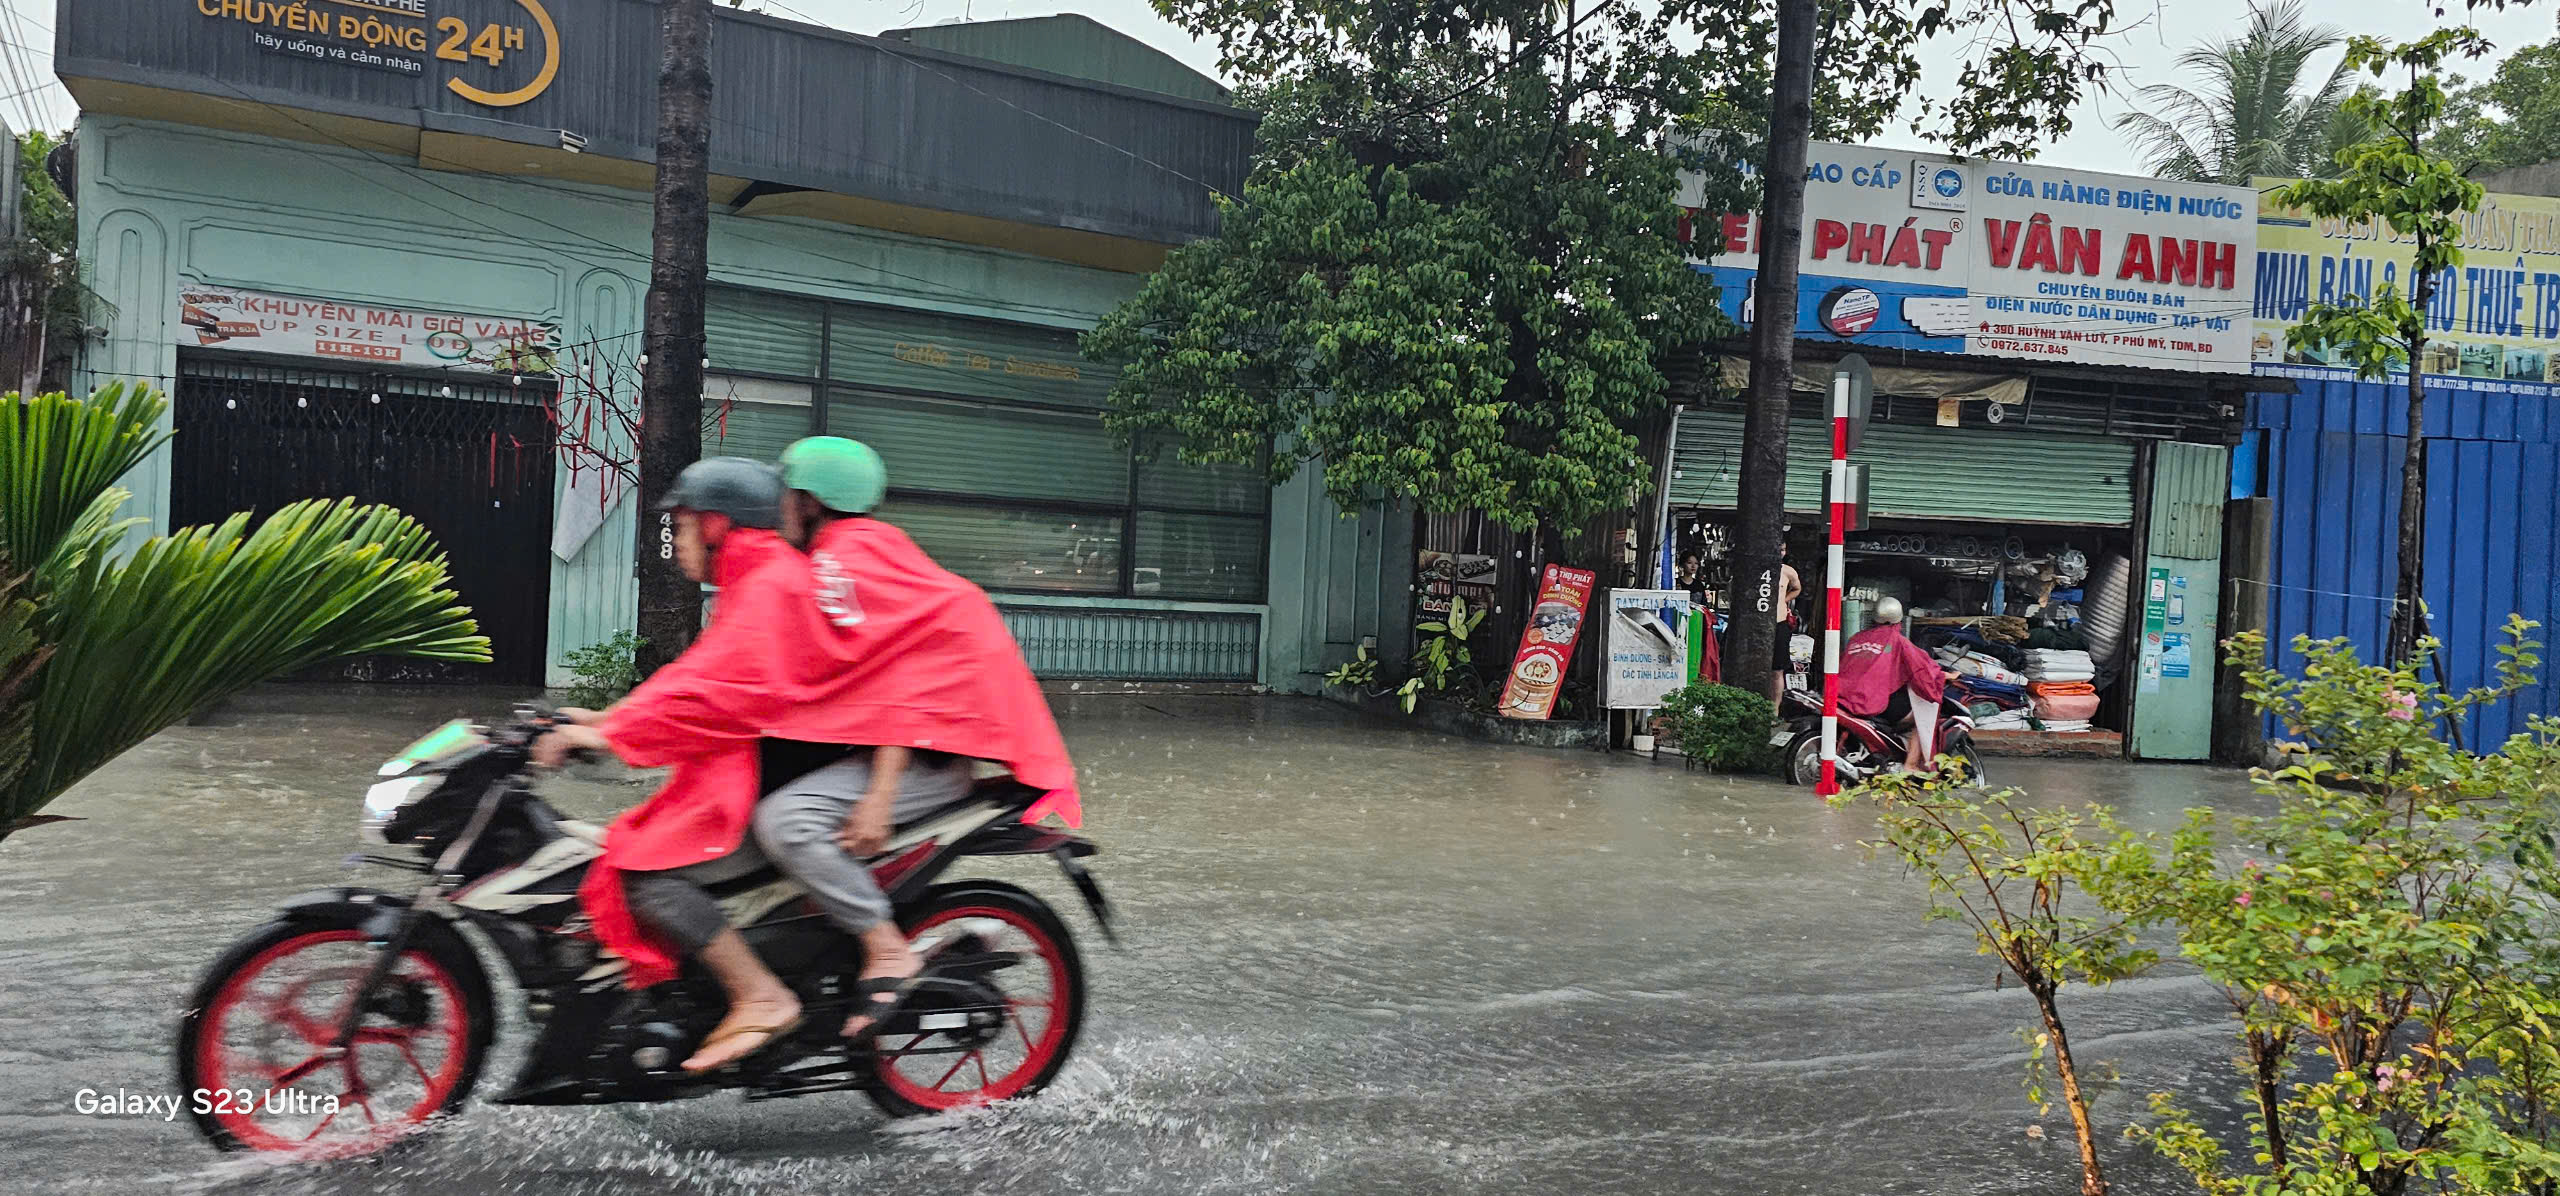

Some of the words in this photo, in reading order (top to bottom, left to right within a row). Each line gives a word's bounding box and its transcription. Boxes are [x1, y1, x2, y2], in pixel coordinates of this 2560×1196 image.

[255, 32, 283, 50] hãy
[287, 36, 326, 58] uống
[329, 45, 347, 60] và
[350, 48, 382, 65] cảm
[386, 54, 422, 72] nhận
[339, 15, 428, 51] ĐỘNG
[435, 16, 525, 68] 24H
[1808, 161, 1845, 184] AO
[1851, 160, 1902, 190] CẤP
[1986, 171, 2035, 198] CỬA
[2043, 178, 2110, 206] HÀNG
[2117, 188, 2172, 216] ĐIỆN
[2179, 195, 2243, 221] NƯỚC
[1812, 217, 1953, 271] PHÁT
[1984, 212, 2102, 276] VÂN
[2116, 232, 2237, 291] ANH
[2037, 281, 2101, 301] CHUYÊN
[2106, 288, 2149, 304] BUÔN
[2152, 289, 2186, 308] BÁN
[2252, 251, 2310, 322] MUA
[2465, 256, 2526, 338] THUÊ
[259, 319, 299, 333] UP
[314, 324, 385, 343] SIZE
[366, 310, 413, 329] MÃI
[423, 315, 465, 334] GIỜ
[475, 321, 547, 343] VÀNG
[1986, 296, 2025, 313] ĐIỆN
[2030, 300, 2073, 317] NƯỚC
[2078, 303, 2111, 321] DÂN
[2115, 309, 2157, 326] DỤNG
[2173, 313, 2200, 330] TẠP
[2205, 314, 2232, 332] VẬT
[317, 341, 398, 359] 11H-13H
[1991, 339, 2069, 356] 0972.637.845
[2018, 324, 2057, 340] HUỲNH
[2060, 329, 2083, 342] VĂN
[2122, 334, 2145, 348] PHÚ
[660, 512, 673, 560] 468
[1757, 569, 1772, 613] 466
